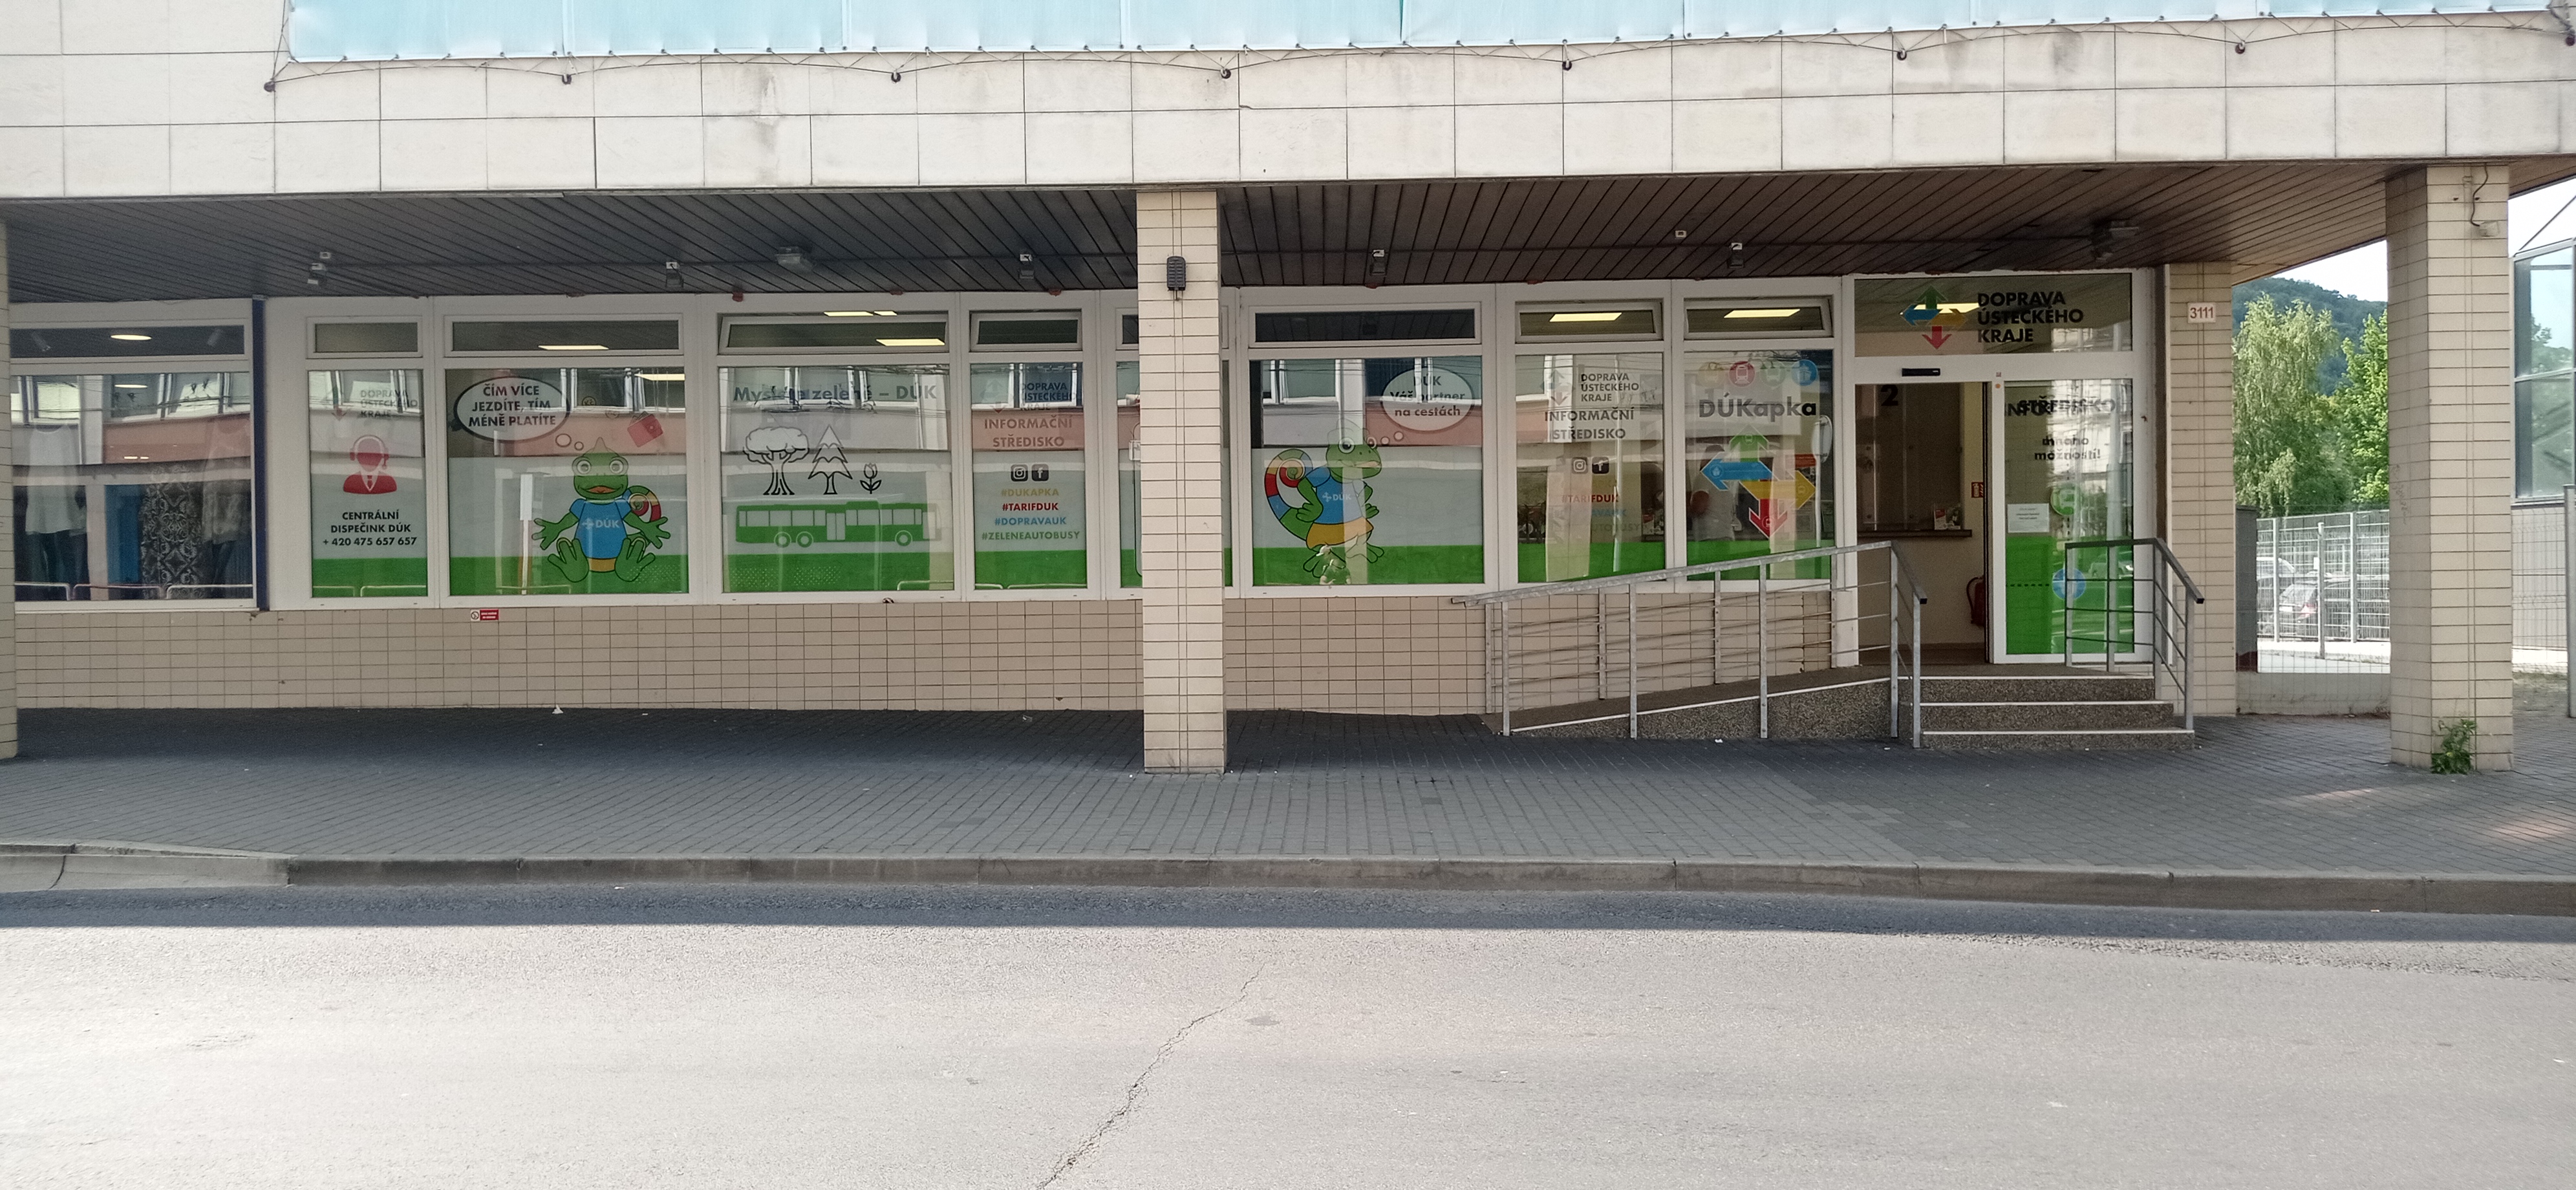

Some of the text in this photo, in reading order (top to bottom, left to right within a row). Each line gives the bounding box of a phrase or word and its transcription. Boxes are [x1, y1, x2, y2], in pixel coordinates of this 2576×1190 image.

[1977, 291, 2066, 307] DOPRAVA
[1977, 305, 2084, 325] ÚSTECKÉHO
[2189, 307, 2213, 319] 3111
[1977, 329, 2034, 343] KRAJE
[1581, 373, 1629, 382] DOPRAVA
[483, 384, 539, 396] ČÍM VÍCE
[1581, 382, 1639, 392] ÚSTECKÉHO
[1581, 393, 1612, 402] KRAJE
[1881, 384, 1898, 406] 2
[361, 398, 418, 408] ÚSTECKO
[472, 398, 550, 413] JEZDÍTE, TÍM
[1699, 392, 1817, 422] DÚKapka
[1414, 405, 1461, 416] cestách
[1545, 407, 1635, 422] INFORMAČNÍ
[468, 413, 556, 427] MÉNĚ PLATÍTE
[984, 415, 1073, 429] INFORMAČNÍ
[1552, 426, 1626, 440] STŘEDISKO
[993, 434, 1065, 448] STŘEDISKO
[1001, 488, 1059, 497] #DUKAPKA
[1002, 503, 1058, 511] #TARIFDUK
[342, 509, 400, 520] CENTRÁLNÍ
[596, 517, 620, 528] DÚK
[994, 517, 1067, 526] #DOPRAVAUK
[330, 522, 411, 533] DISPEČINK DÚK
[982, 531, 1080, 540] #ZELENEAUTOBUSY
[332, 537, 352, 546] 420
[376, 537, 395, 545] 657
[398, 537, 417, 545] 657
